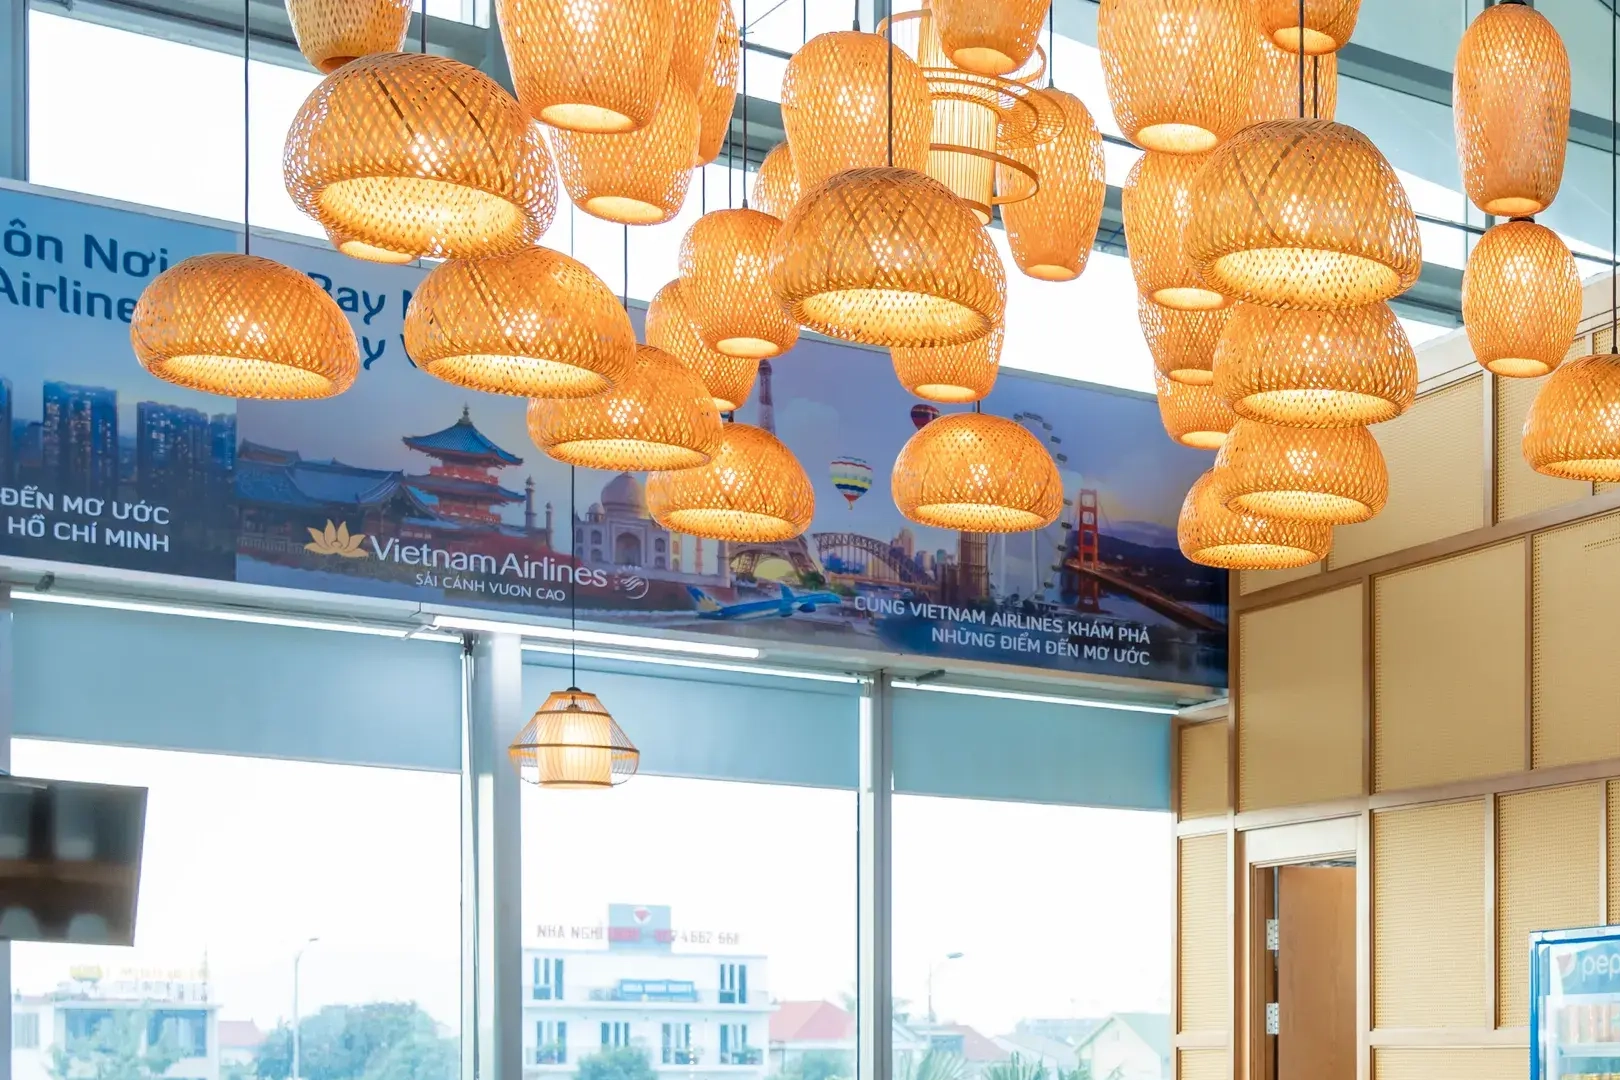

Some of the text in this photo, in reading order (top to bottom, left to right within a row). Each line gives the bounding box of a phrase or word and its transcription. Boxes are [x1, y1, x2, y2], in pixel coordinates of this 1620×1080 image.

[84, 233, 168, 278] Nơi
[0, 264, 138, 323] Airline
[63, 494, 105, 516] MƠ
[112, 499, 170, 525] ƯỚC
[53, 521, 97, 544] CHÍ
[105, 527, 169, 552] MINH
[370, 535, 497, 575] Vietnam
[500, 552, 608, 588] Airlines
[442, 573, 485, 593] CÁNH
[536, 587, 566, 602] CAO
[854, 594, 1151, 645] CÙNG VIETNAM AIRLINES KHÁM PHÁ
[932, 626, 1150, 666] NHỮNG ĐIỂM ĐẾN MƠ ƯỚC
